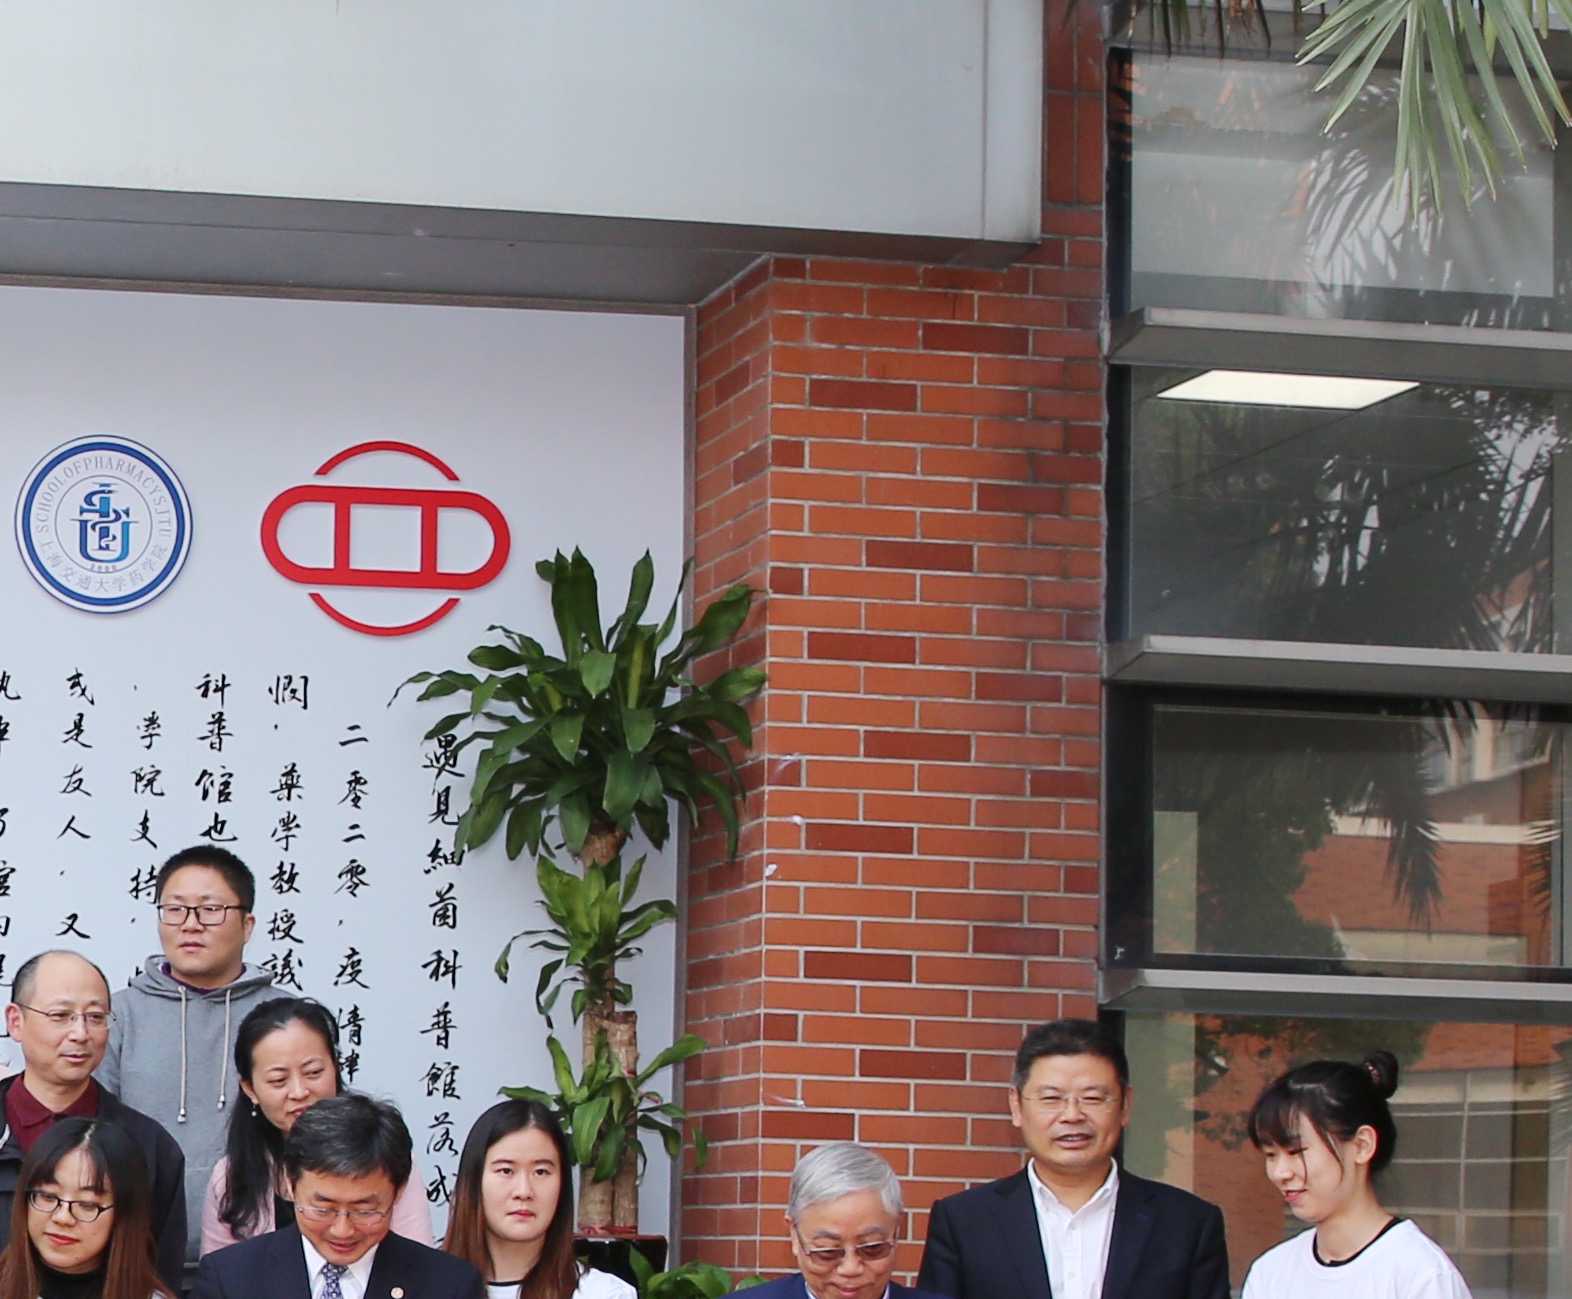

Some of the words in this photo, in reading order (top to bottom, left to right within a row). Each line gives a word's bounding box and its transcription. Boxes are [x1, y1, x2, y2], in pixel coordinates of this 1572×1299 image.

[40, 539, 168, 593] 上海交通大学药学院
[418, 733, 466, 1245] 遇見細菌科普館落成
